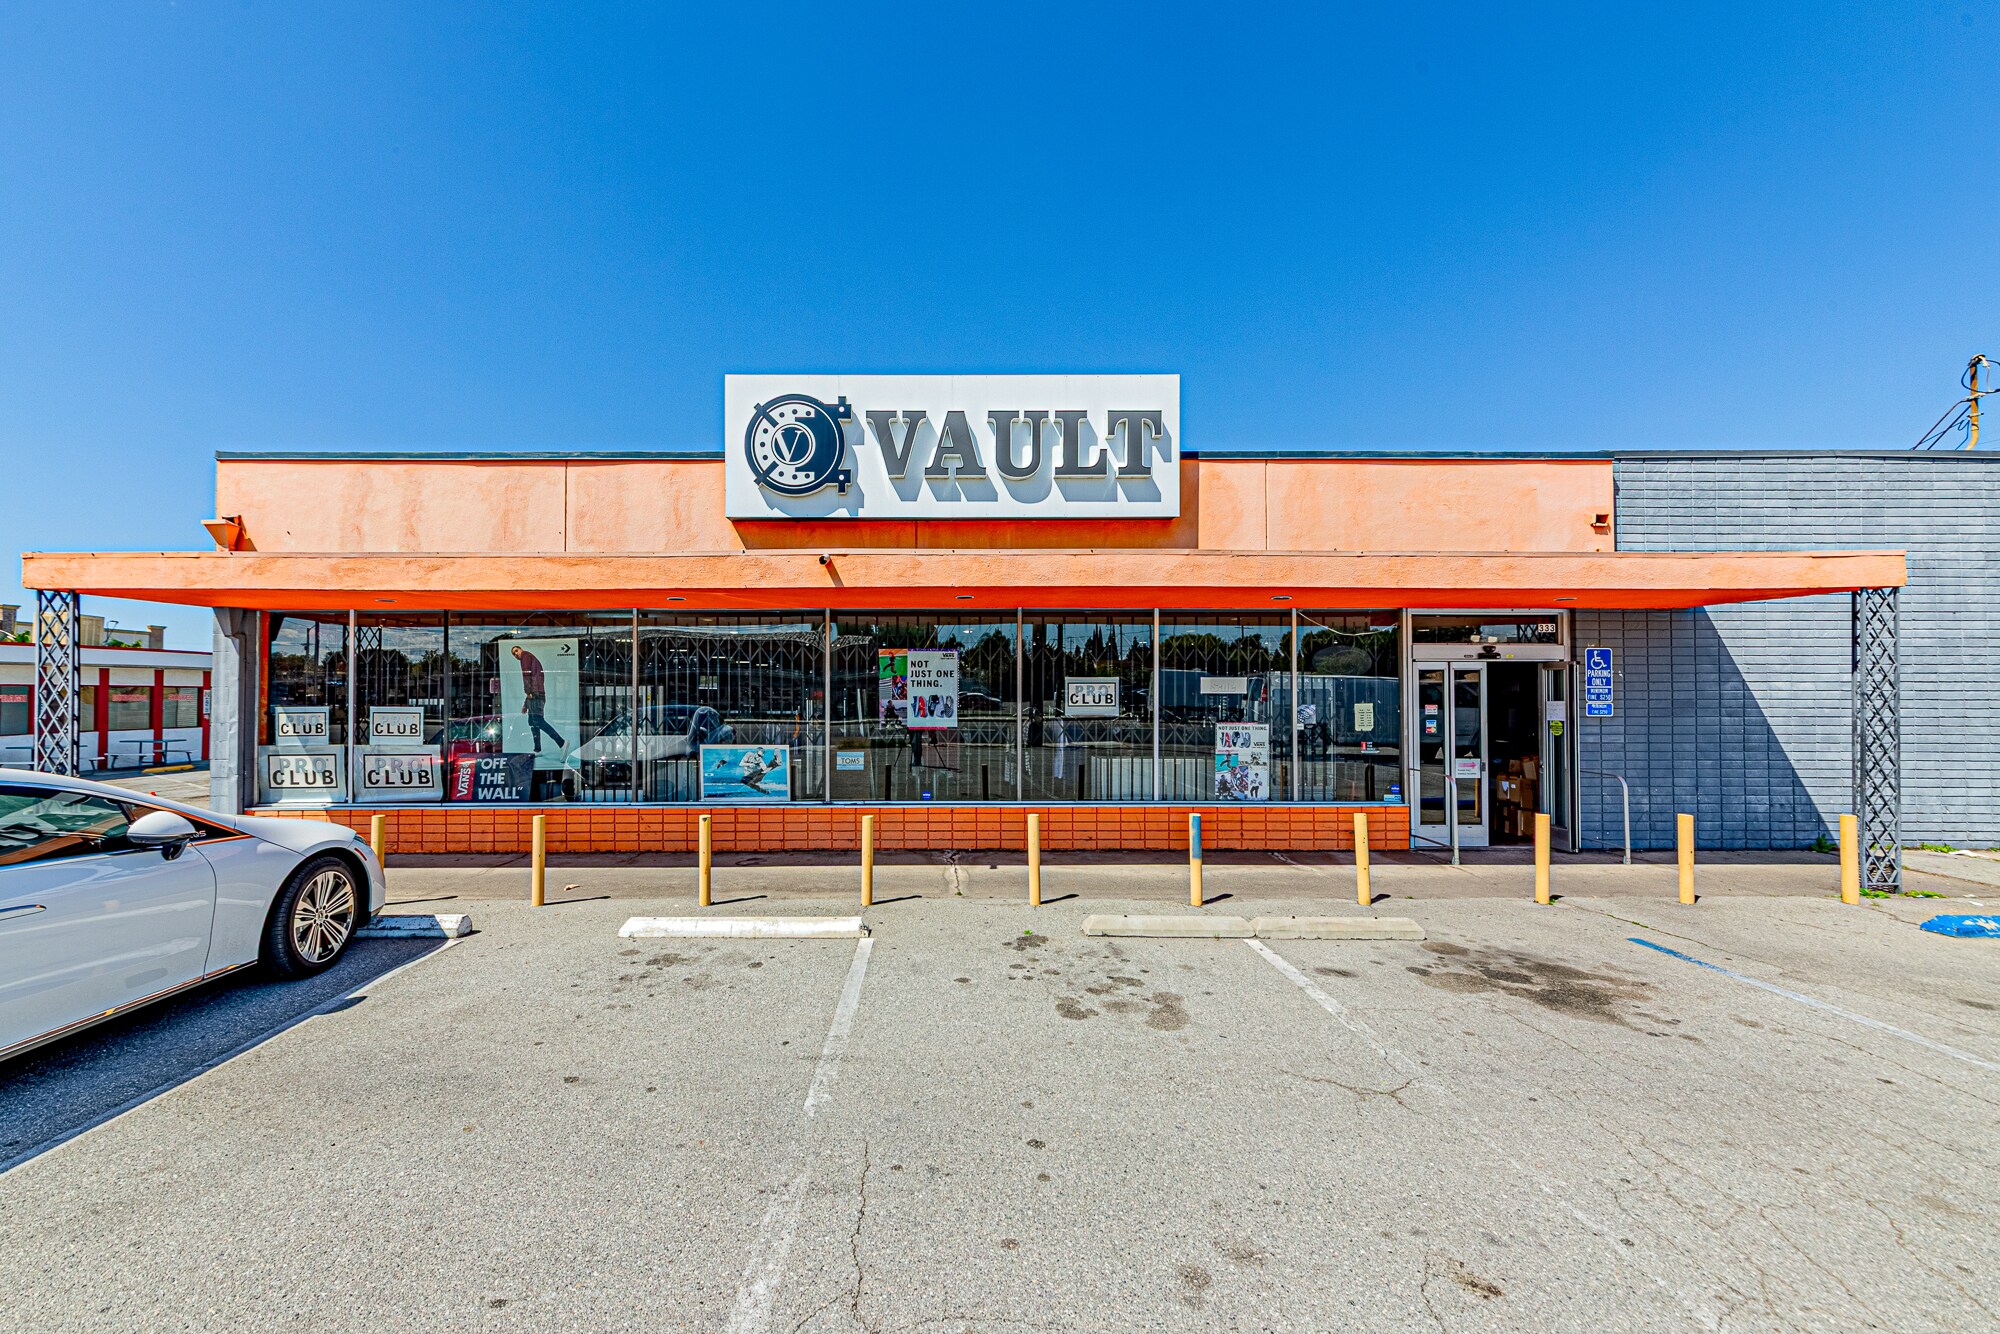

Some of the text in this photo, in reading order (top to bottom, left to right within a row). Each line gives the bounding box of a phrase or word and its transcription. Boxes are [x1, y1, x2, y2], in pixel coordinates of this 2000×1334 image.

[775, 429, 802, 461] V
[866, 410, 1162, 479] VAULT
[1588, 669, 1610, 678] PARKING
[1076, 685, 1108, 697] PRO
[1070, 693, 1114, 704] CLUB
[287, 715, 320, 726] PRO
[381, 715, 413, 726] PRO
[280, 723, 324, 734] CLUB
[375, 723, 418, 734] CLUB
[280, 758, 326, 773] PRO
[375, 758, 422, 773] PRO
[272, 770, 334, 786] CLUB
[368, 770, 430, 786] CLUB
[480, 772, 506, 784] THE
